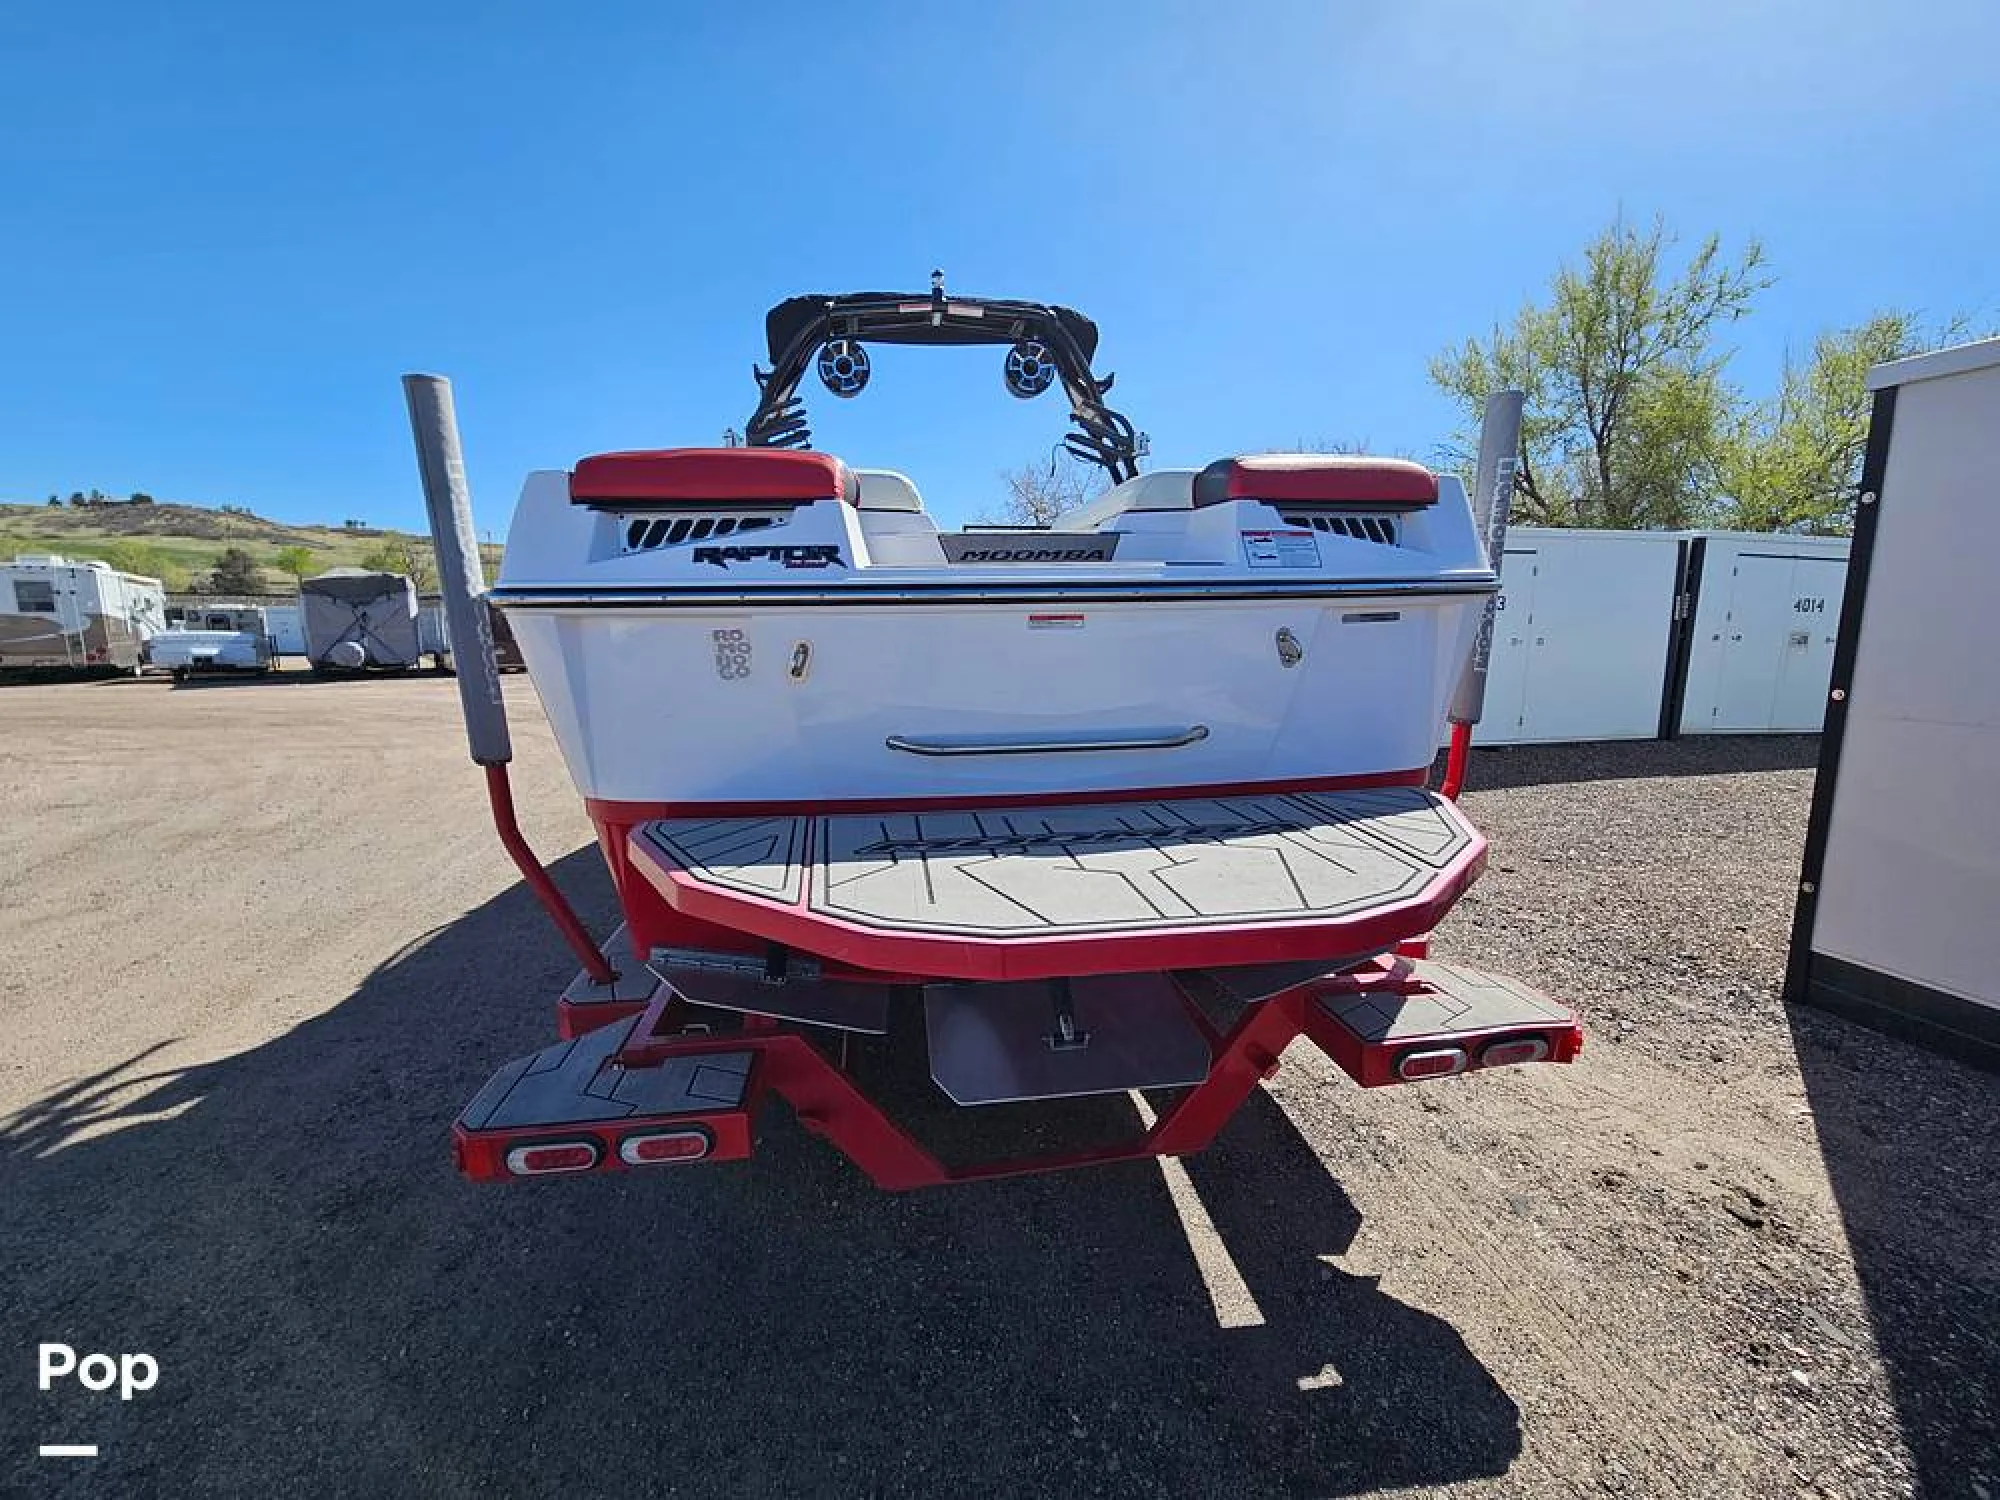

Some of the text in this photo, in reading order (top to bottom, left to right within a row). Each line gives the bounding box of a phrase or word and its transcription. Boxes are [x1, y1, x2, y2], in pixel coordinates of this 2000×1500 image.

[693, 545, 849, 570] RAPTOR
[960, 549, 1105, 561] MOOMBA
[1793, 597, 1825, 613] 4014
